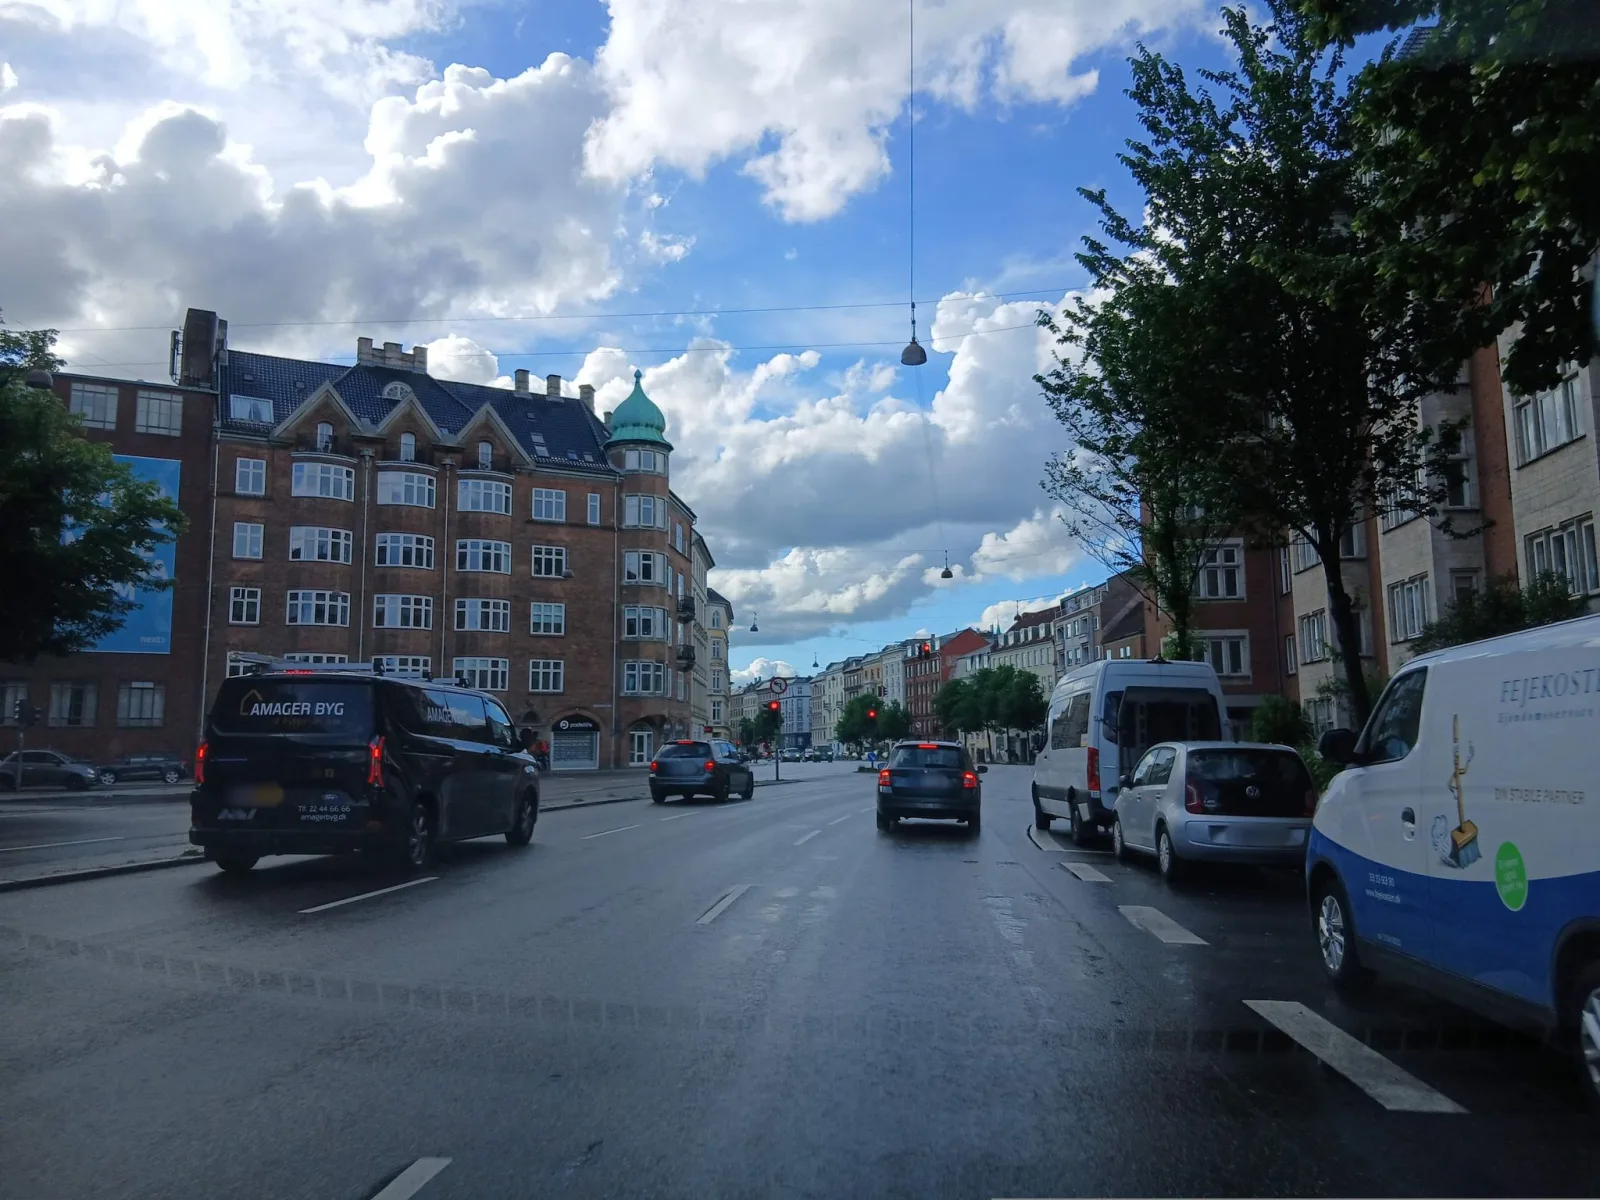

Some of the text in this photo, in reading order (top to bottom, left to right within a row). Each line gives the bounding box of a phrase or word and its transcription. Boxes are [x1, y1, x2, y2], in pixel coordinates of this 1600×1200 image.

[250, 702, 345, 716] AMAGER BYG
[309, 805, 318, 813] 22
[318, 805, 328, 813] 44
[329, 805, 339, 813] 66
[340, 805, 351, 813] 66
